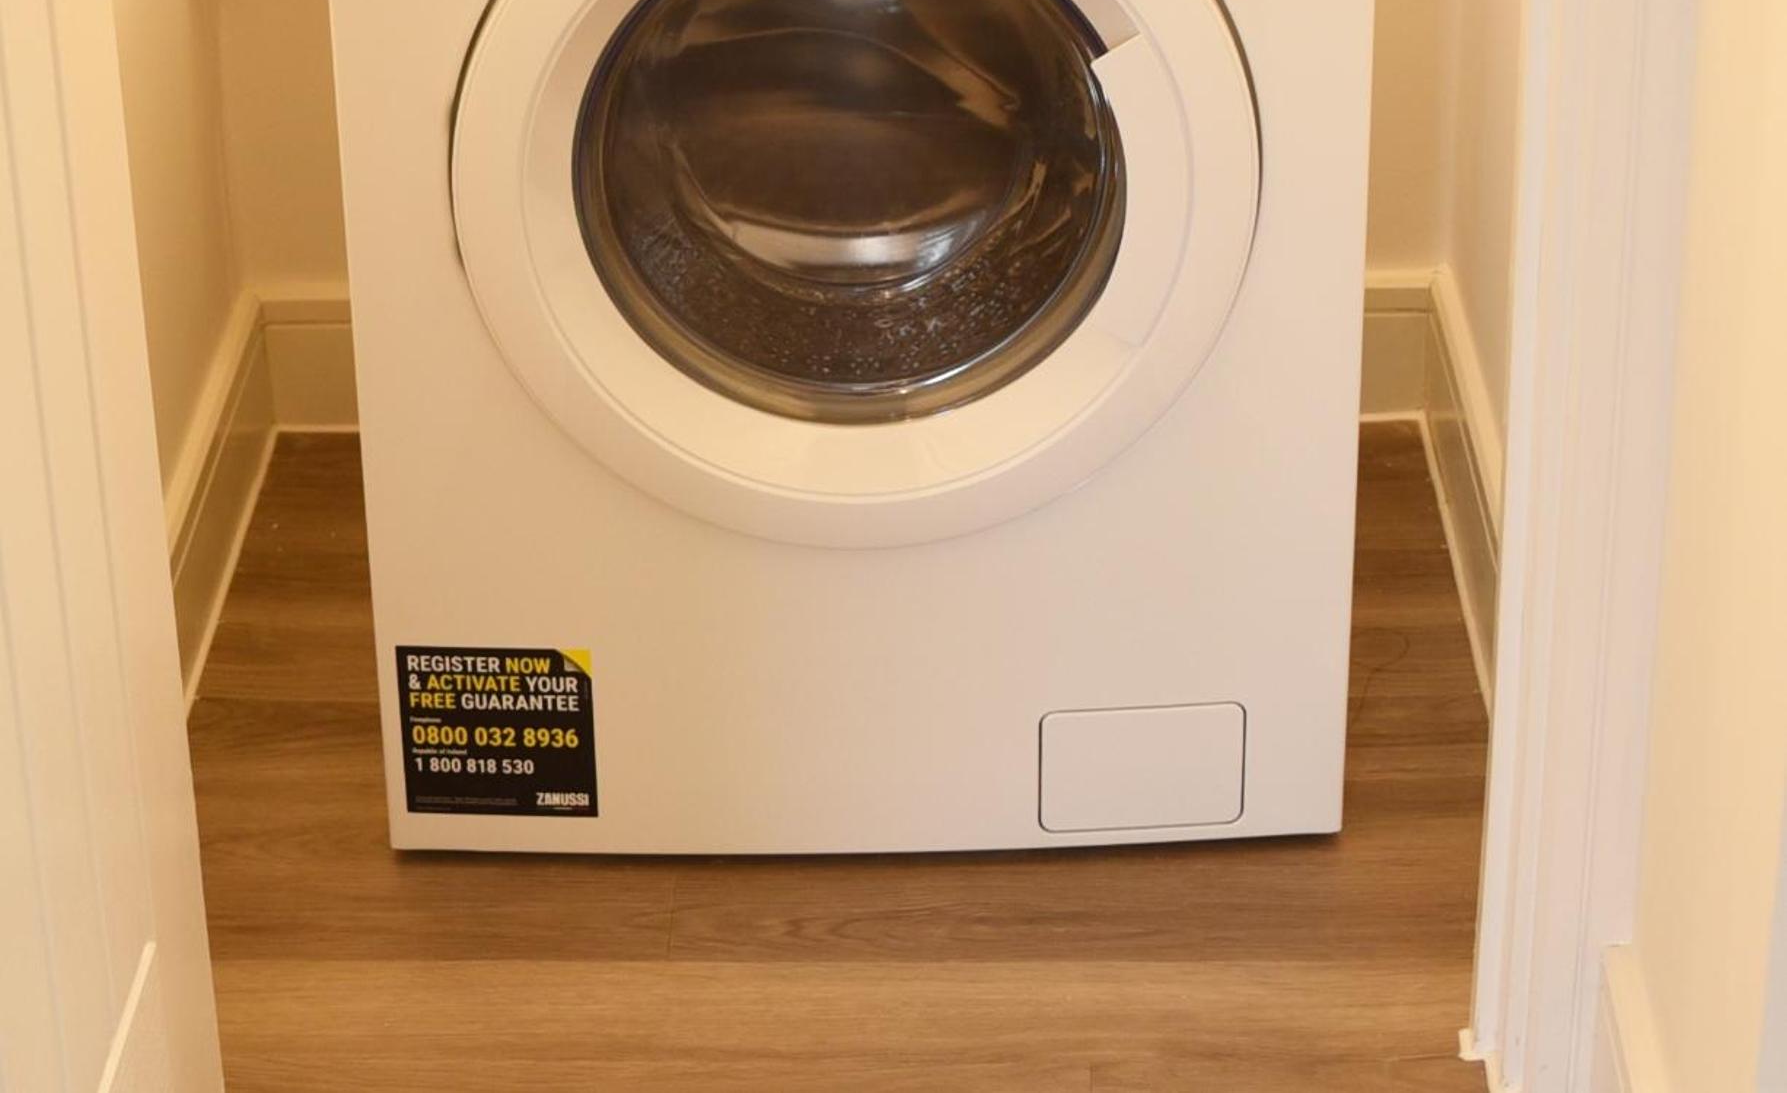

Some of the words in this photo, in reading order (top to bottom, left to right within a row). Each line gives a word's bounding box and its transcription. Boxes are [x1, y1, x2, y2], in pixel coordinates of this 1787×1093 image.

[407, 655, 500, 673] REGISTER
[505, 657, 551, 674] NOW
[408, 674, 421, 690] &
[427, 674, 521, 692] ACTIVATE
[525, 676, 578, 693] YOUR
[409, 692, 457, 709] FREE
[461, 694, 579, 711] GUARANTEE
[412, 725, 468, 745] 0800
[474, 726, 516, 747] 032
[523, 728, 579, 748] 8936
[415, 757, 423, 772] 1
[429, 757, 462, 773] 800
[466, 758, 497, 774] 818
[502, 759, 535, 775] 530
[536, 791, 590, 806] ZANUSSI
